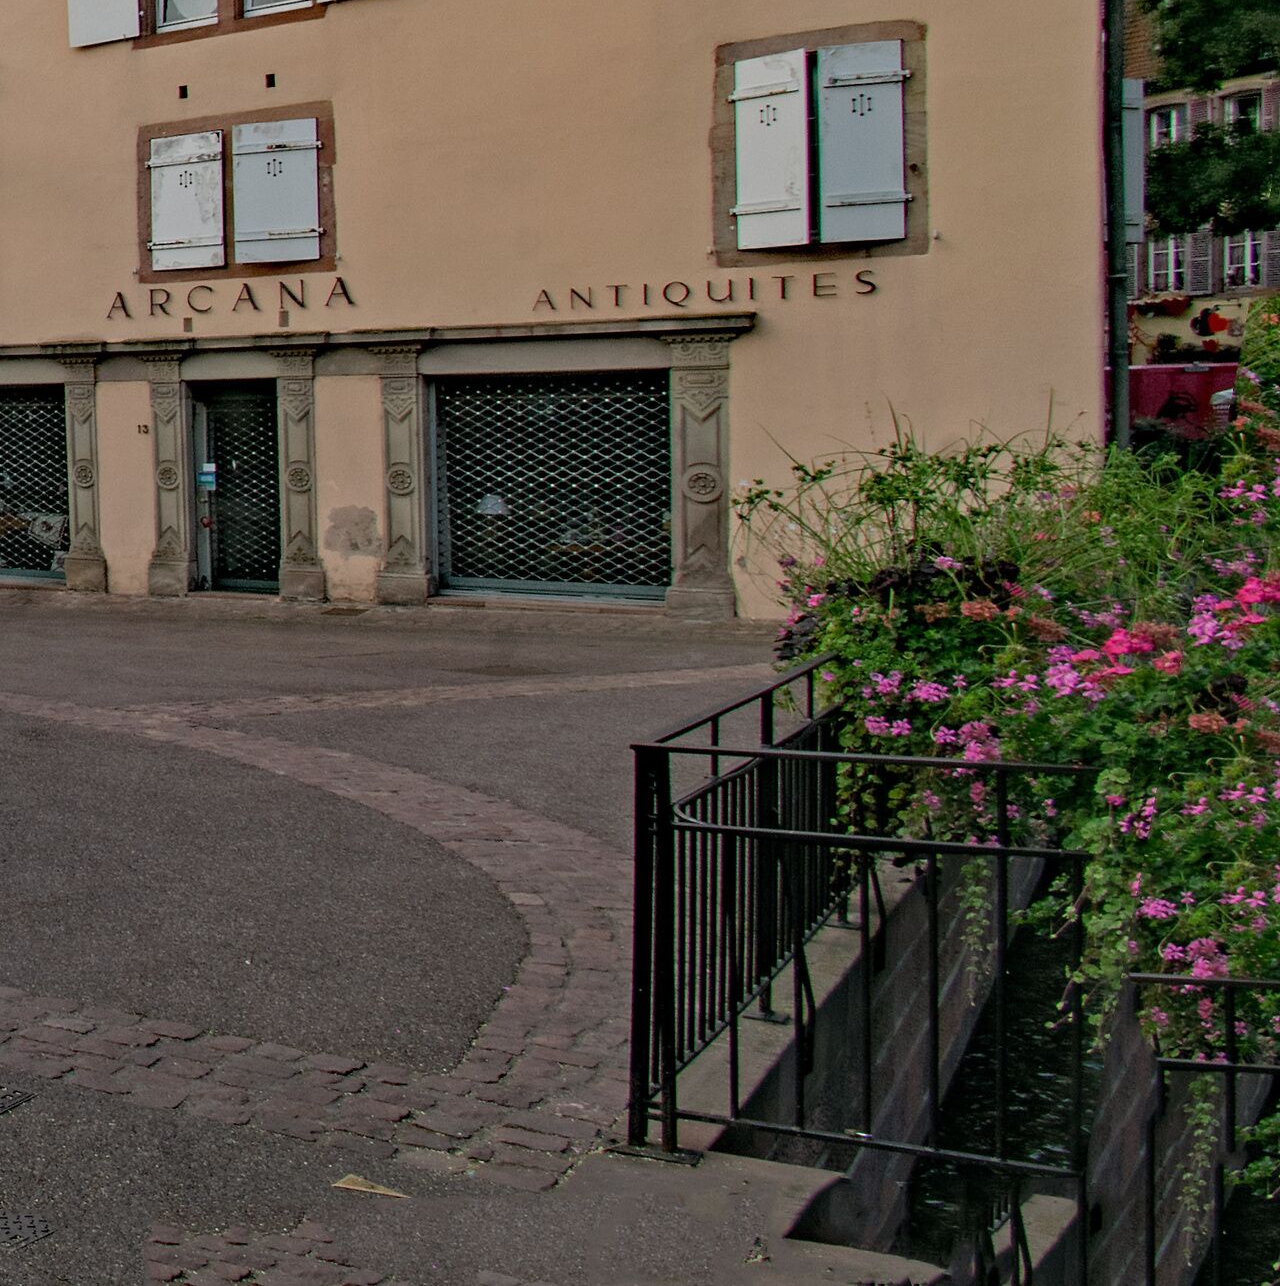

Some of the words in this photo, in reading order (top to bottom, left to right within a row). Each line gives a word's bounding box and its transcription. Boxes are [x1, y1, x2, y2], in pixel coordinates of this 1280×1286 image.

[106, 276, 356, 319] ARCANA
[532, 269, 880, 310] ANTIQUITES
[137, 424, 149, 434] 13
